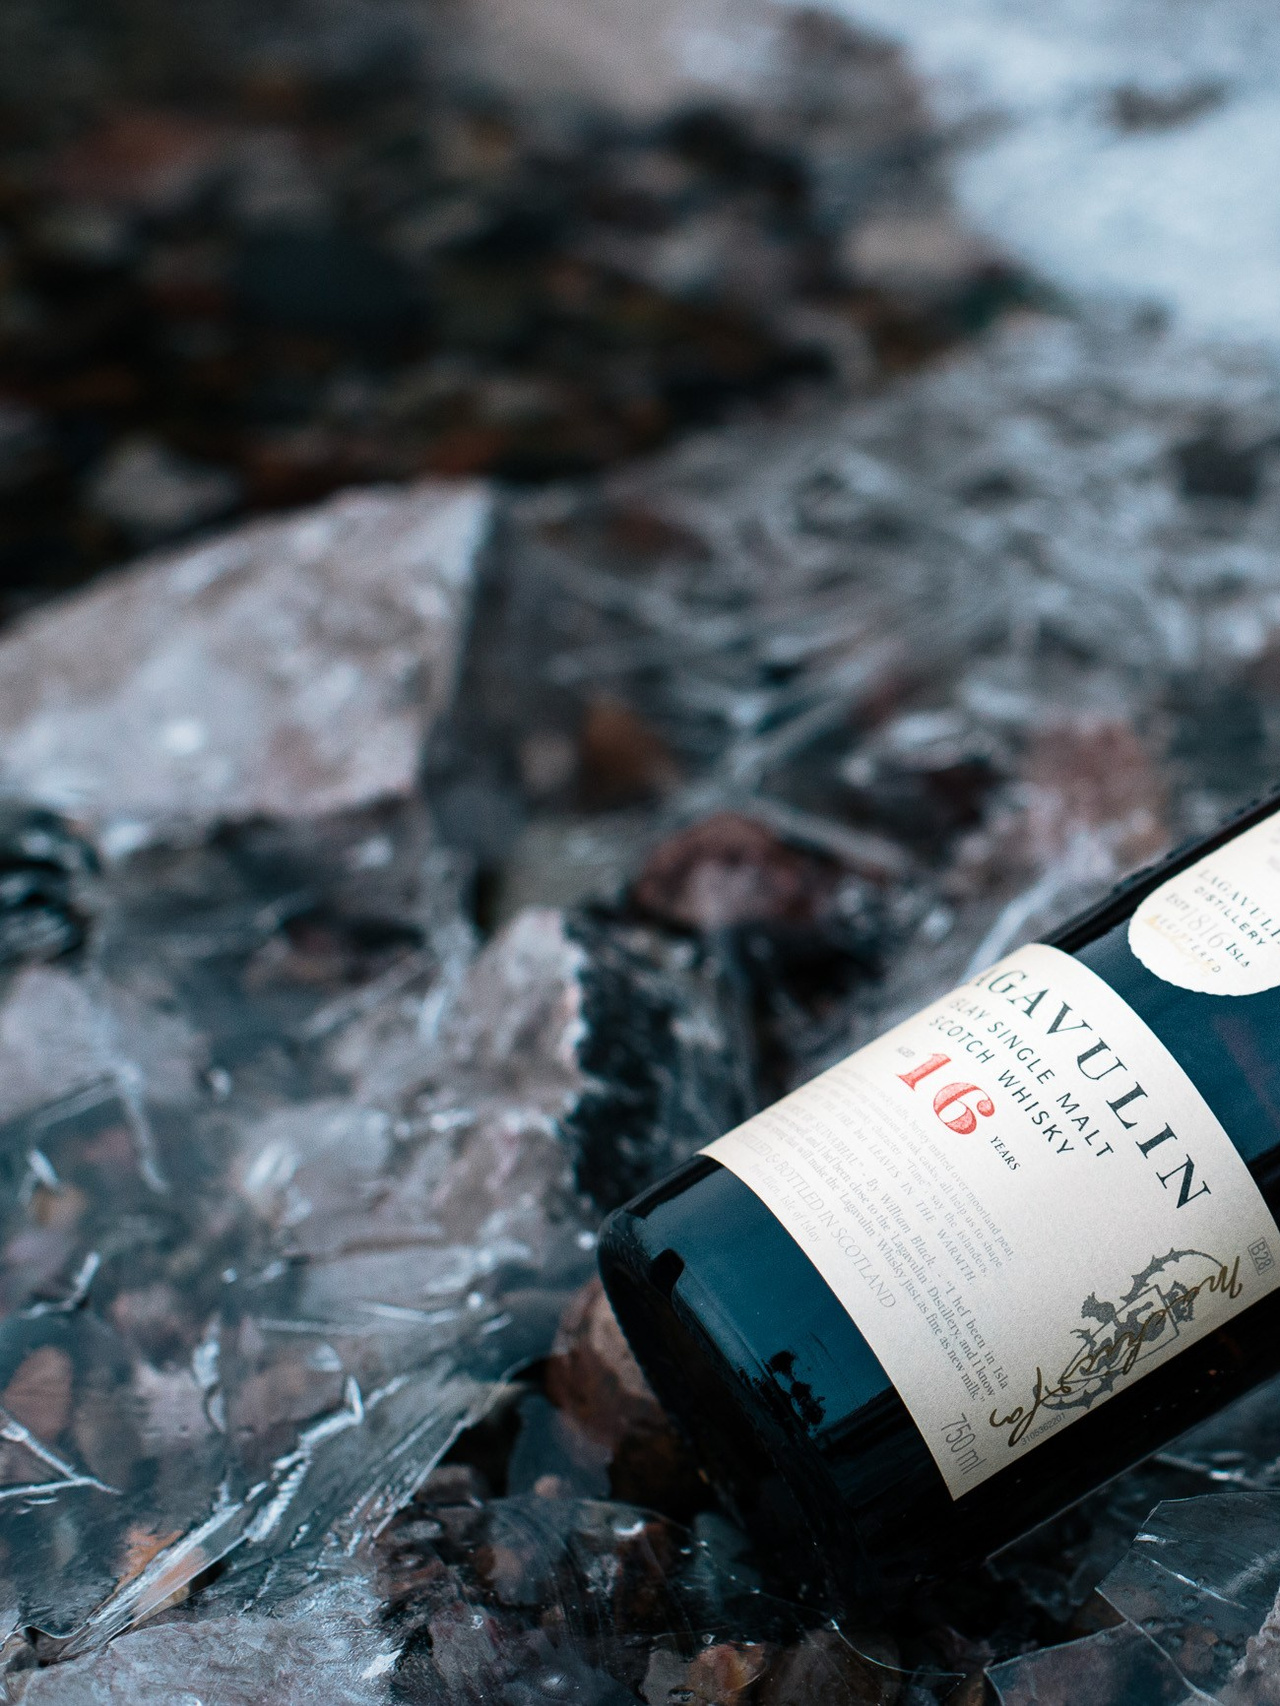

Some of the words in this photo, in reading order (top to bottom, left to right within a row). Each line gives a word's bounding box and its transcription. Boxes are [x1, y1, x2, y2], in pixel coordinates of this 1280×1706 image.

[1178, 909, 1231, 949] 1816
[1194, 886, 1266, 946] DISTILLERY
[896, 1053, 995, 1135] 16
[990, 1135, 1021, 1171] YEARS
[929, 1015, 995, 1064] SCOTCH
[998, 1069, 1075, 1154] WHISKY
[950, 998, 990, 1021] SLAY
[987, 1021, 1055, 1084] SINGLE
[1056, 1092, 1114, 1157] MALT
[764, 1152, 781, 1164] &
[774, 1161, 824, 1210] BOTTLED
[818, 1210, 839, 1228] IN
[831, 1228, 896, 1308] SCOTLAND
[780, 1194, 795, 1211] Isle
[792, 1211, 807, 1221] of
[868, 1144, 902, 1178] LEAVES
[900, 1182, 914, 1196] IN
[915, 1200, 935, 1222] THE
[938, 1229, 976, 1285] WARMTH.
[906, 1140, 922, 1156] oak
[939, 1181, 954, 1195] all
[950, 1194, 967, 1215] help
[965, 1216, 975, 1228] us
[973, 1228, 984, 1239] to
[983, 1241, 1002, 1268] shape
[909, 1120, 929, 1144] barley
[928, 1144, 955, 1172] malted
[951, 1172, 969, 1191] over
[966, 1192, 1002, 1235] moorland
[994, 1236, 1014, 1261] peat,
[930, 1194, 945, 1210] say
[944, 1211, 958, 1228] the
[957, 1231, 988, 1277] islanders,
[808, 1158, 828, 1178] make
[825, 1176, 840, 1191] the
[877, 1238, 906, 1278] Whisky
[899, 1277, 922, 1302] just
[916, 1300, 930, 1314] as
[925, 1313, 943, 1336] fine
[939, 1336, 951, 1350] as
[948, 1350, 965, 1371] new
[833, 1160, 851, 1182] been
[848, 1181, 870, 1204] close
[866, 1203, 879, 1215] to
[875, 1214, 892, 1232] the
[927, 1287, 961, 1339] Distillery,
[959, 1340, 978, 1360] and
[975, 1365, 996, 1396] know
[866, 1177, 879, 1192] By
[881, 1194, 911, 1233] William
[910, 1235, 936, 1268] Black.
[952, 1296, 972, 1317] hef
[966, 1318, 986, 1349] been
[984, 1350, 996, 1365] in
[992, 1366, 1009, 1390] Isla
[1251, 1242, 1271, 1271] B28
[941, 1412, 976, 1452] 750
[956, 1449, 987, 1475] ml
[1019, 1412, 1065, 1446] 3105362201
